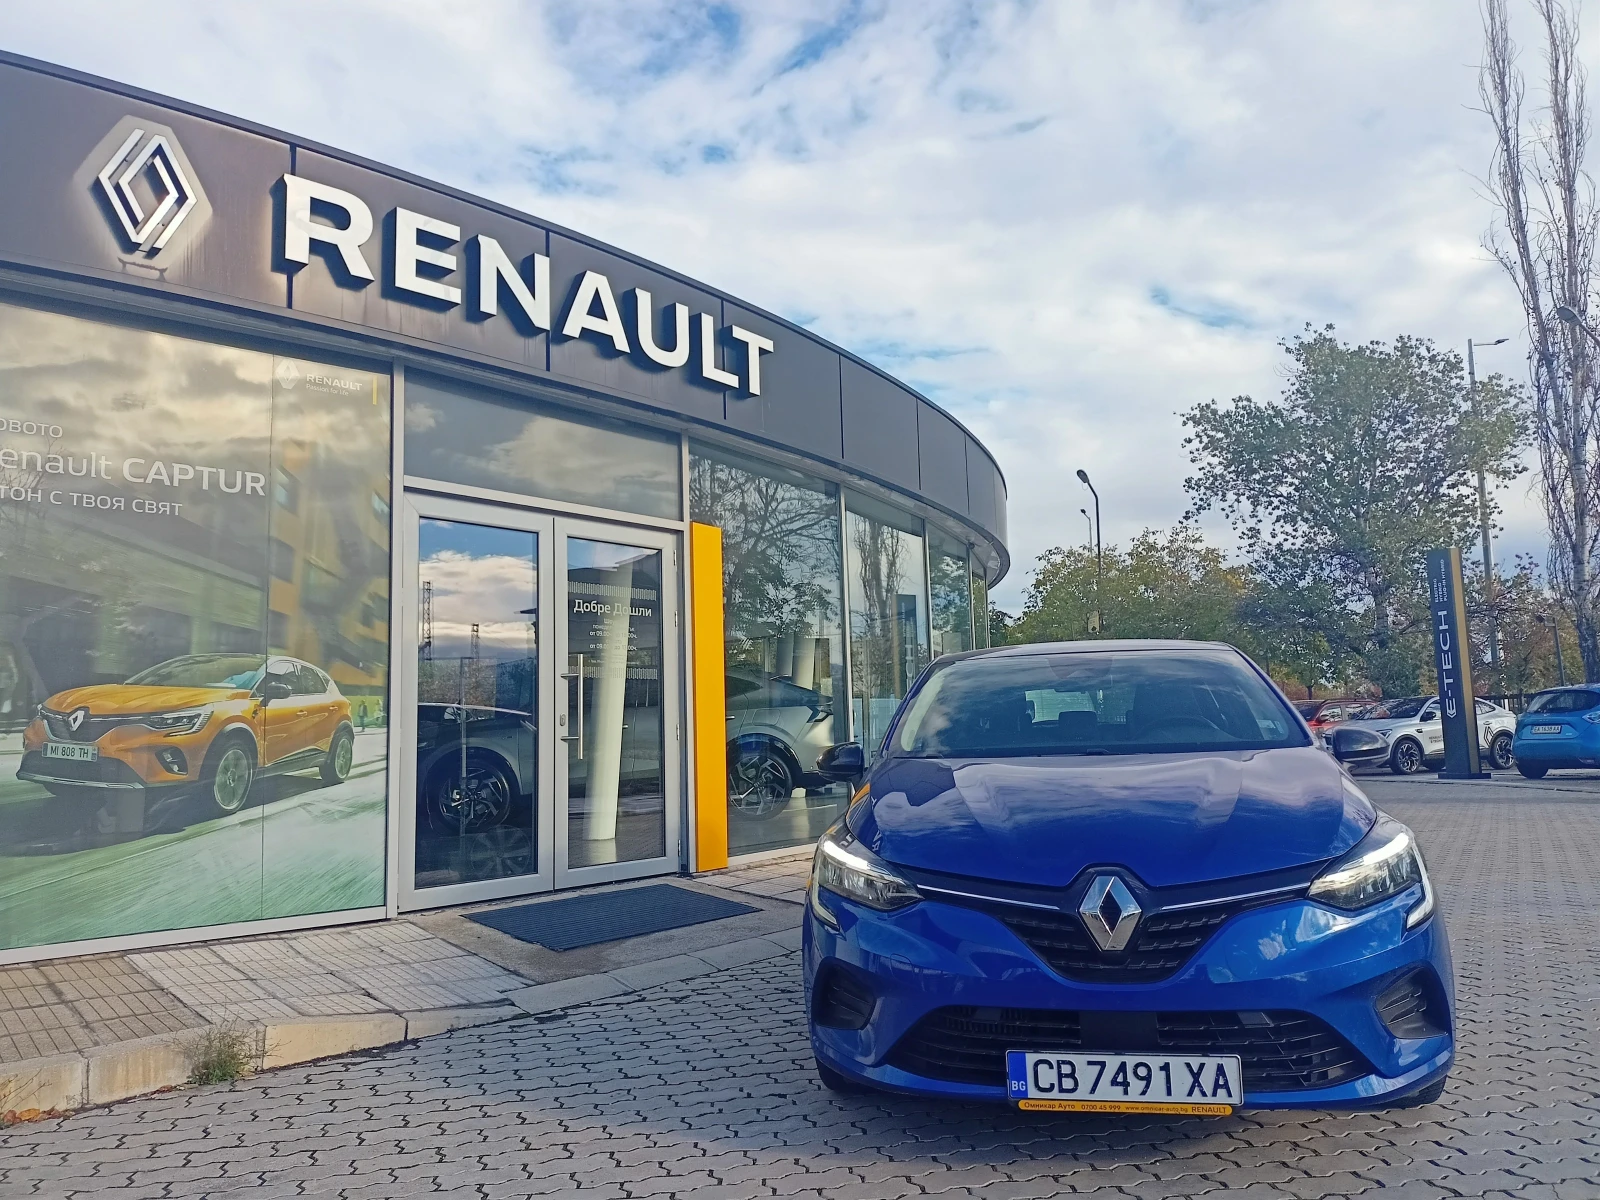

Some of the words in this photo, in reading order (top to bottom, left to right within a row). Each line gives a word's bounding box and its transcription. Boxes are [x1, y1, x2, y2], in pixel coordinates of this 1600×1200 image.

[282, 173, 775, 397] RENAULT
[305, 383, 329, 393] Passion
[339, 388, 349, 396] life
[306, 373, 363, 391] RENAULT
[0, 448, 113, 480] enault
[122, 457, 266, 496] CAPTUR
[49, 490, 62, 505] С
[69, 492, 125, 511] ТВОЯ
[132, 499, 183, 516] СВЯТ
[573, 599, 611, 615] Добре
[613, 603, 652, 617] Дошли
[1437, 610, 1458, 719] E-TECH
[50, 745, 59, 756] MI
[61, 746, 76, 757] 808
[78, 747, 89, 758] TH
[1011, 1081, 1026, 1091] BG
[1033, 1059, 1079, 1094] CB
[1086, 1060, 1173, 1097] 7491
[1184, 1062, 1233, 1098] XA
[1024, 1101, 1057, 1109] Омникар
[1058, 1102, 1076, 1110] Ауто
[1081, 1103, 1097, 1111] 0700
[1191, 1106, 1227, 1114] RENAULT
